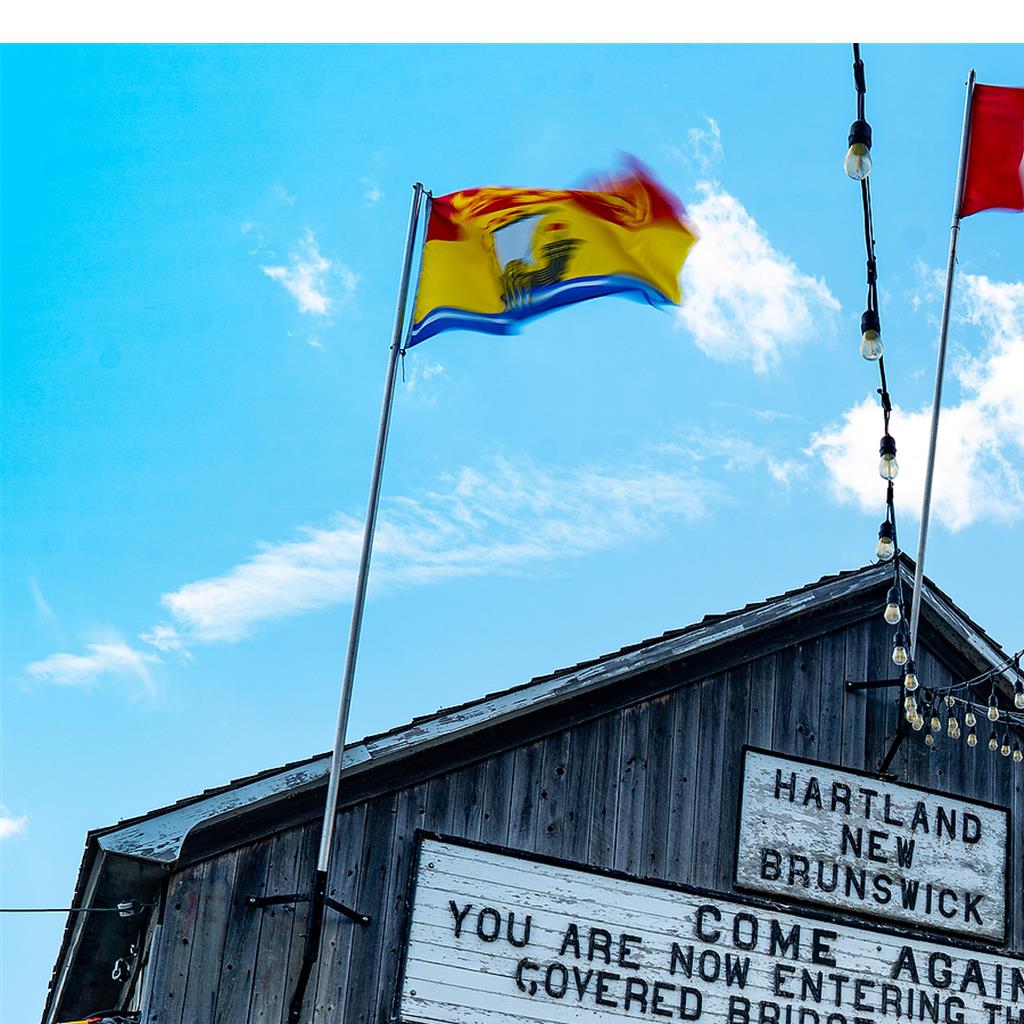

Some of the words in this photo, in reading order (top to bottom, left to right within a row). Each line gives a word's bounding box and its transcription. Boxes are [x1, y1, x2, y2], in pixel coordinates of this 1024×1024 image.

[775, 769, 982, 845] HARTLAND
[842, 825, 915, 869] NEW
[761, 848, 983, 925] BRUNSWICK
[449, 901, 532, 948] YOU
[559, 923, 642, 970] ARE
[670, 942, 750, 989] NOW
[695, 905, 837, 967] COME
[516, 958, 701, 1021] COVERED
